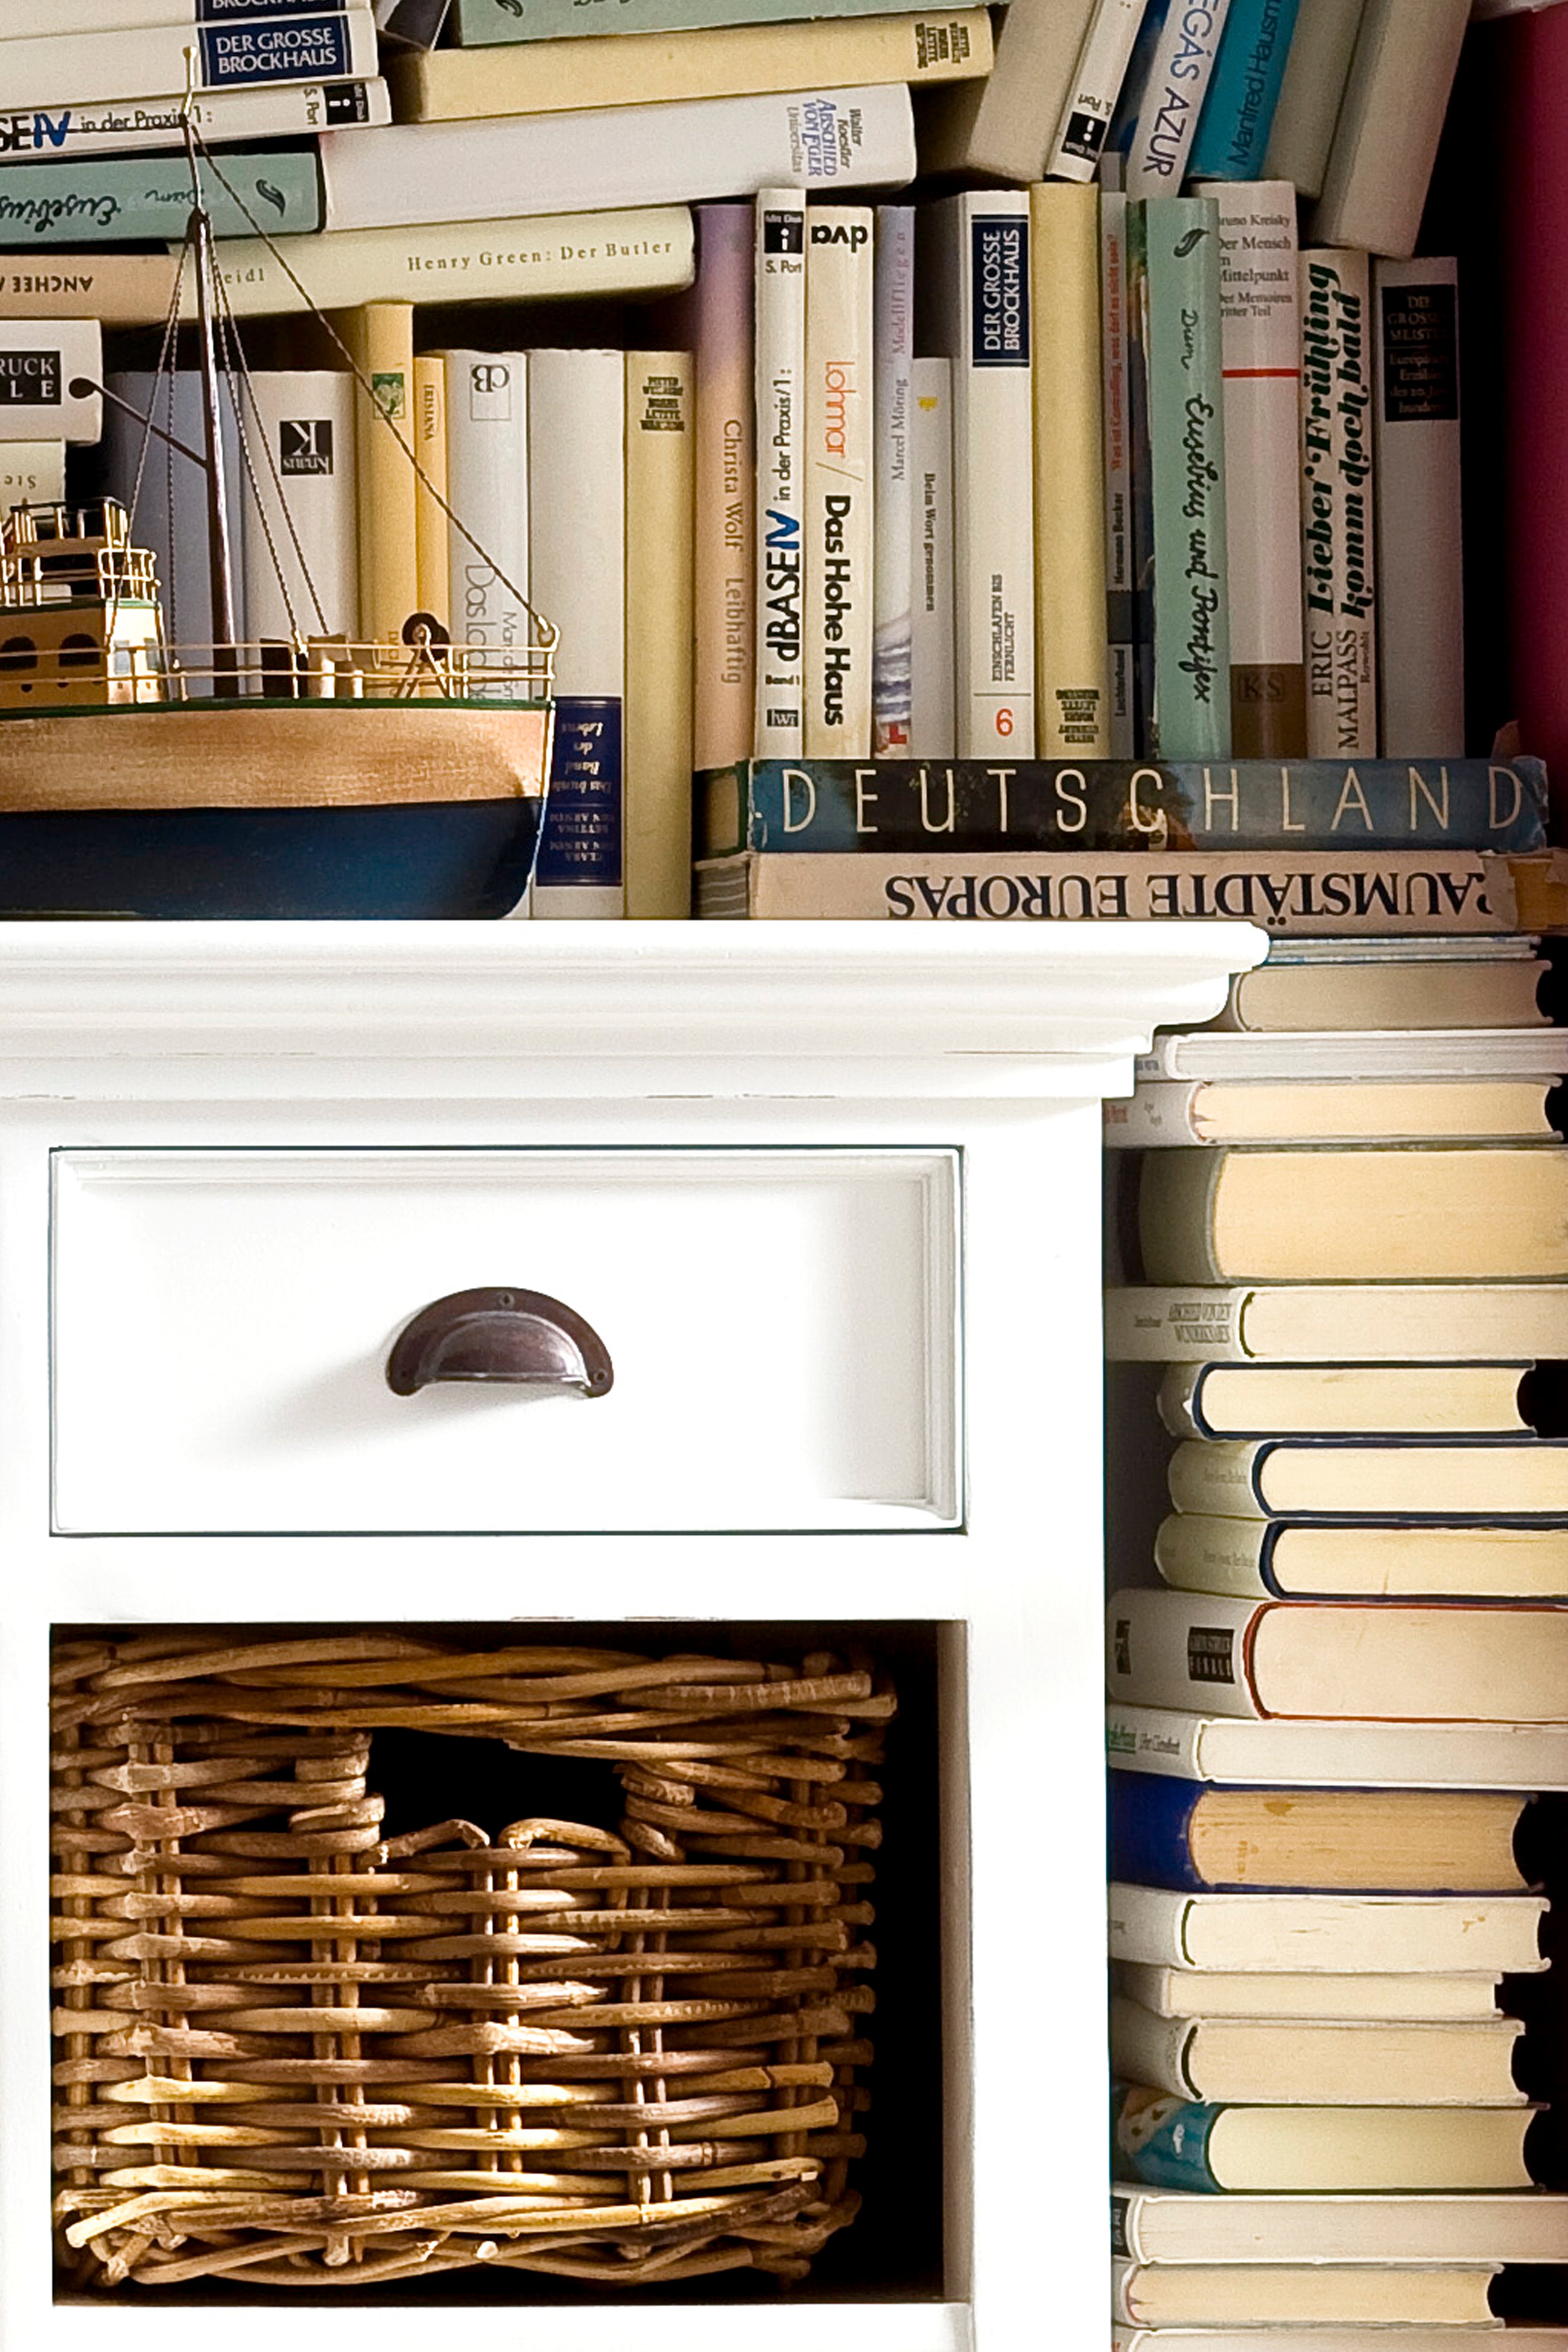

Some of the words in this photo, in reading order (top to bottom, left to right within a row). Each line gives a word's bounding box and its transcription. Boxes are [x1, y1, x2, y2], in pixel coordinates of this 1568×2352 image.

[216, 34, 255, 55] DER
[258, 26, 335, 49] GROSSE
[218, 46, 337, 74] BROCKHAUS
[81, 116, 96, 131] in
[101, 112, 130, 130] der
[849, 108, 862, 146] Walter
[1143, 87, 1190, 176] AZUR
[1228, 76, 1265, 165] Manfred
[811, 225, 868, 253] dva
[1219, 217, 1247, 225] runo
[1250, 214, 1290, 228] Kreisky
[1242, 236, 1291, 250] Mensch
[13, 277, 93, 292] ANCHEE
[218, 268, 264, 284] eidl
[408, 253, 470, 271] Henry
[480, 249, 551, 267] Green:
[561, 246, 596, 260] Der
[606, 240, 672, 257] Butler
[983, 231, 1001, 309] GROSSE
[1004, 229, 1020, 350] BROCKHAUS
[1220, 308, 1247, 317] ritter
[1249, 305, 1271, 316] Teil
[1238, 292, 1292, 303] Memoiren
[984, 313, 1000, 350] DER
[1331, 290, 1361, 384] bald
[1304, 264, 1340, 463] Frühling
[825, 361, 857, 458] Lohmar
[892, 380, 907, 429] Möring
[292, 421, 318, 455] K
[723, 419, 743, 494] Christa
[892, 436, 905, 480] Marcel
[1183, 393, 1218, 518] Eusebius
[1338, 385, 1370, 487] doch
[773, 450, 791, 480] der
[774, 486, 790, 501] in
[725, 502, 743, 551] Wolf
[825, 495, 851, 553] Das
[924, 508, 936, 540] Wort
[1305, 466, 1334, 618] Lieber
[1185, 529, 1219, 579] und
[1341, 493, 1372, 619] komm
[466, 565, 496, 617] Das
[825, 559, 851, 642] Hohe
[721, 578, 745, 685] Leibhaftig
[1179, 585, 1219, 703] Pontifex
[765, 675, 794, 686] Band
[825, 648, 850, 726] Haus
[1312, 631, 1332, 696] ERIC
[1337, 629, 1358, 750] MALPASS
[996, 709, 1013, 736] 6
[782, 766, 1522, 833] DEUTSCHLAND
[885, 875, 1129, 919] EUROPAS
